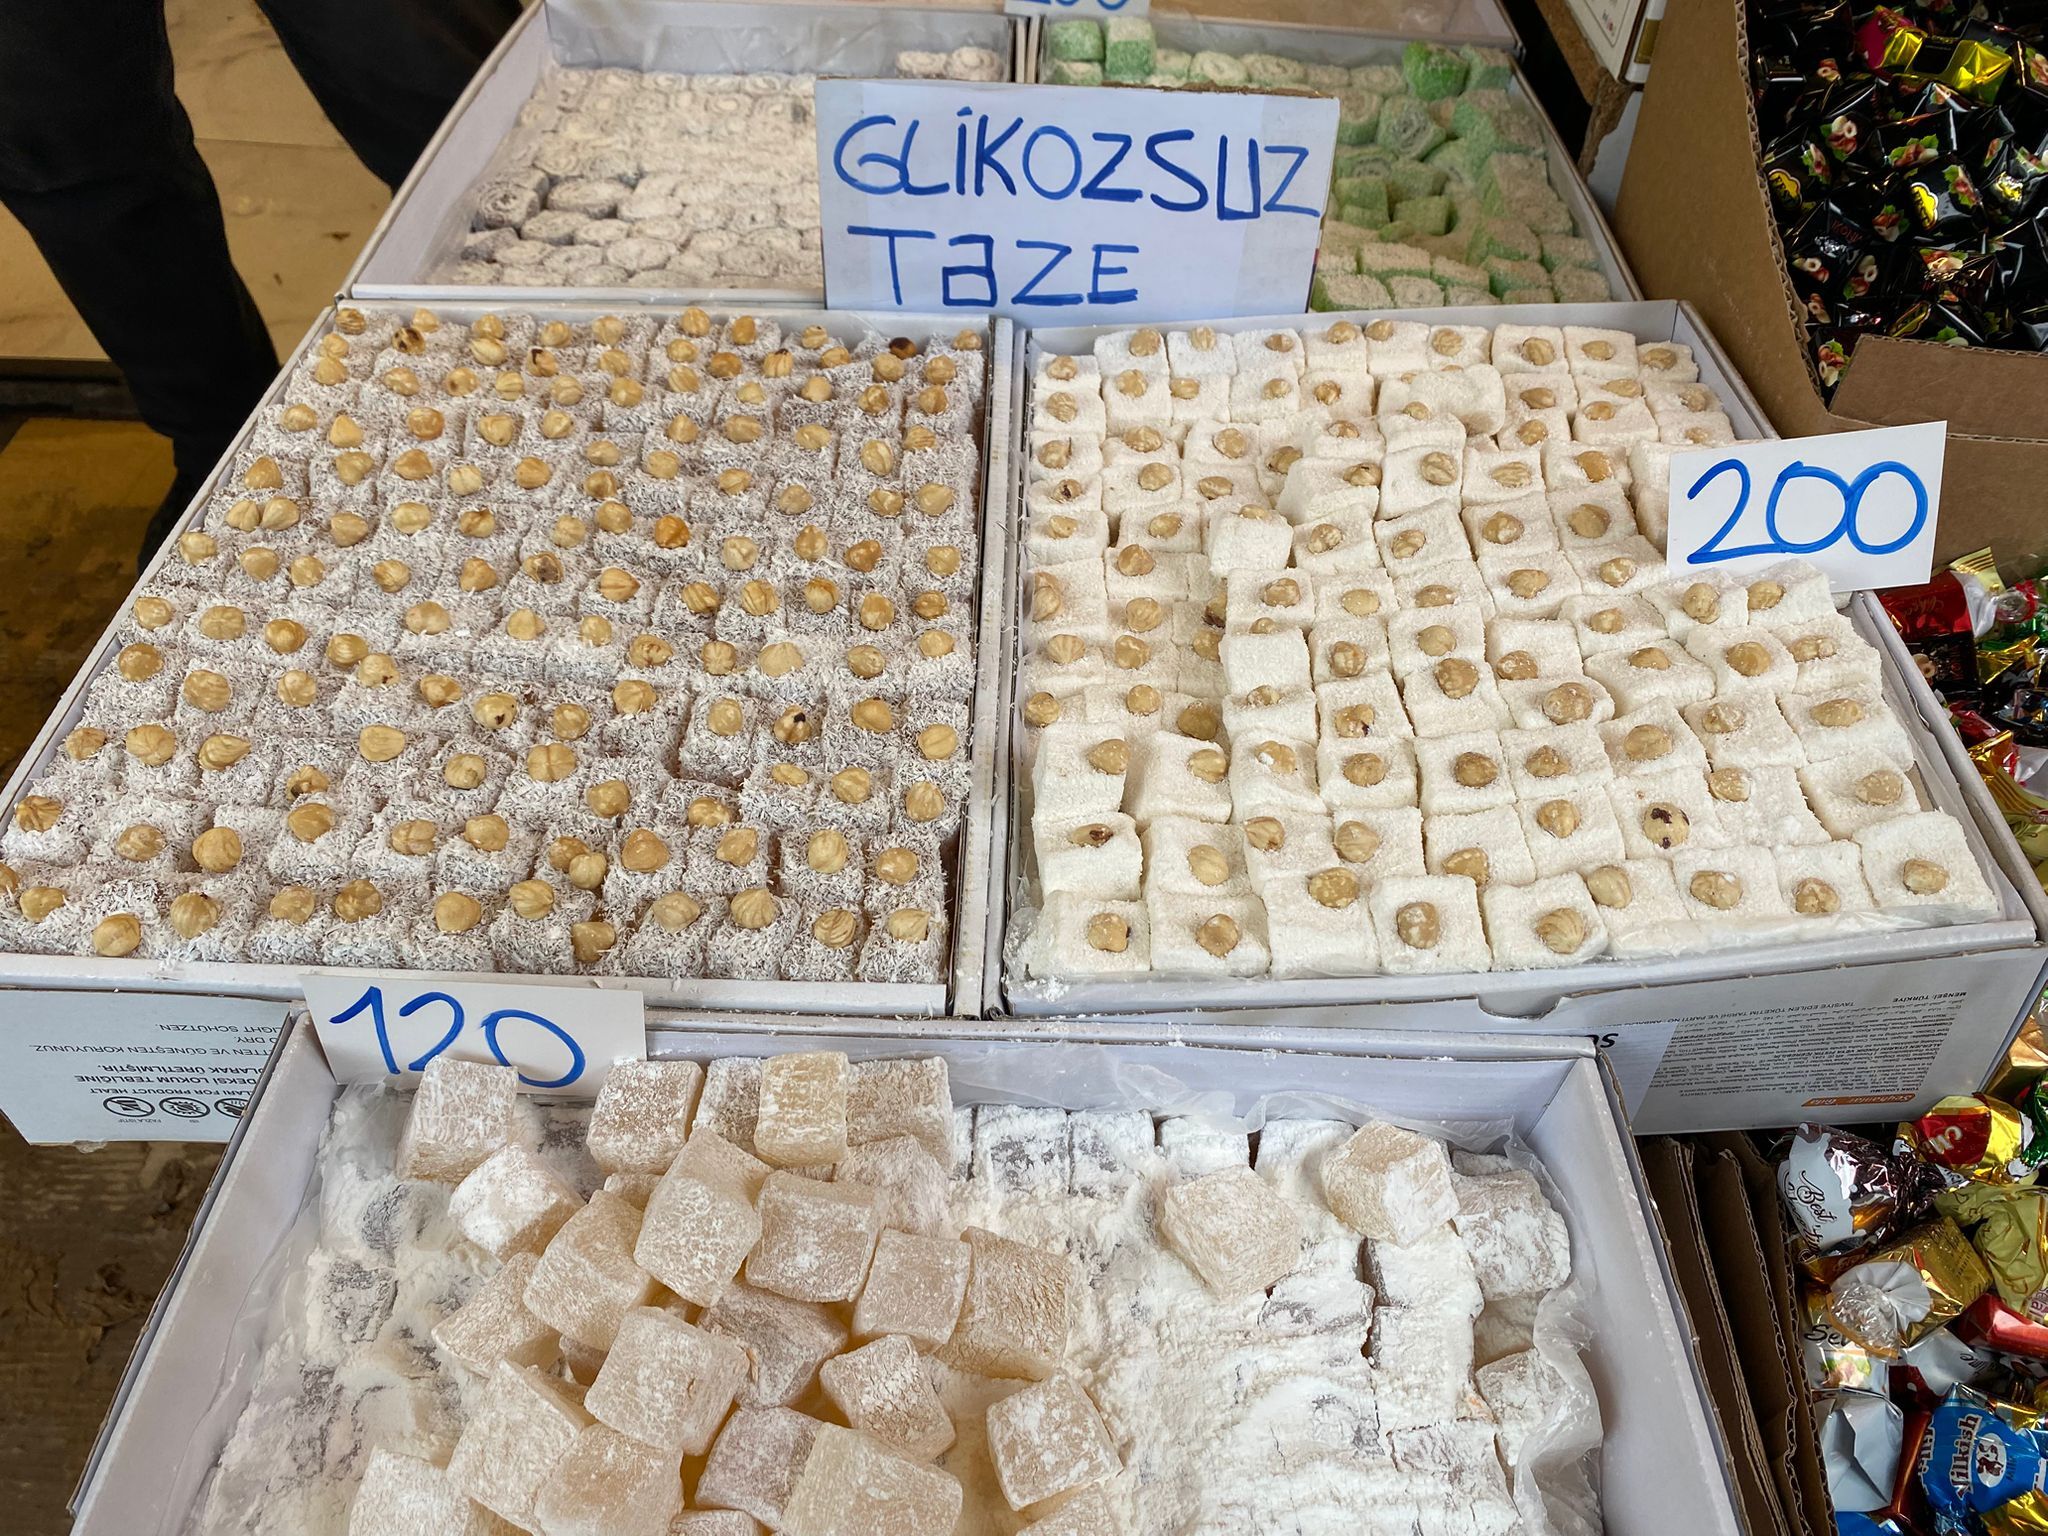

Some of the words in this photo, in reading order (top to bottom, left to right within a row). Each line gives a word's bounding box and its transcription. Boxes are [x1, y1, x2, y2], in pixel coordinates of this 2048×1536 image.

[834, 106, 1321, 220] GLİKOZSUZ
[1687, 459, 1928, 565] 200
[156, 1075, 209, 1084] LOKUM
[329, 986, 586, 1088] 120
[1800, 1170, 1838, 1222] Best
